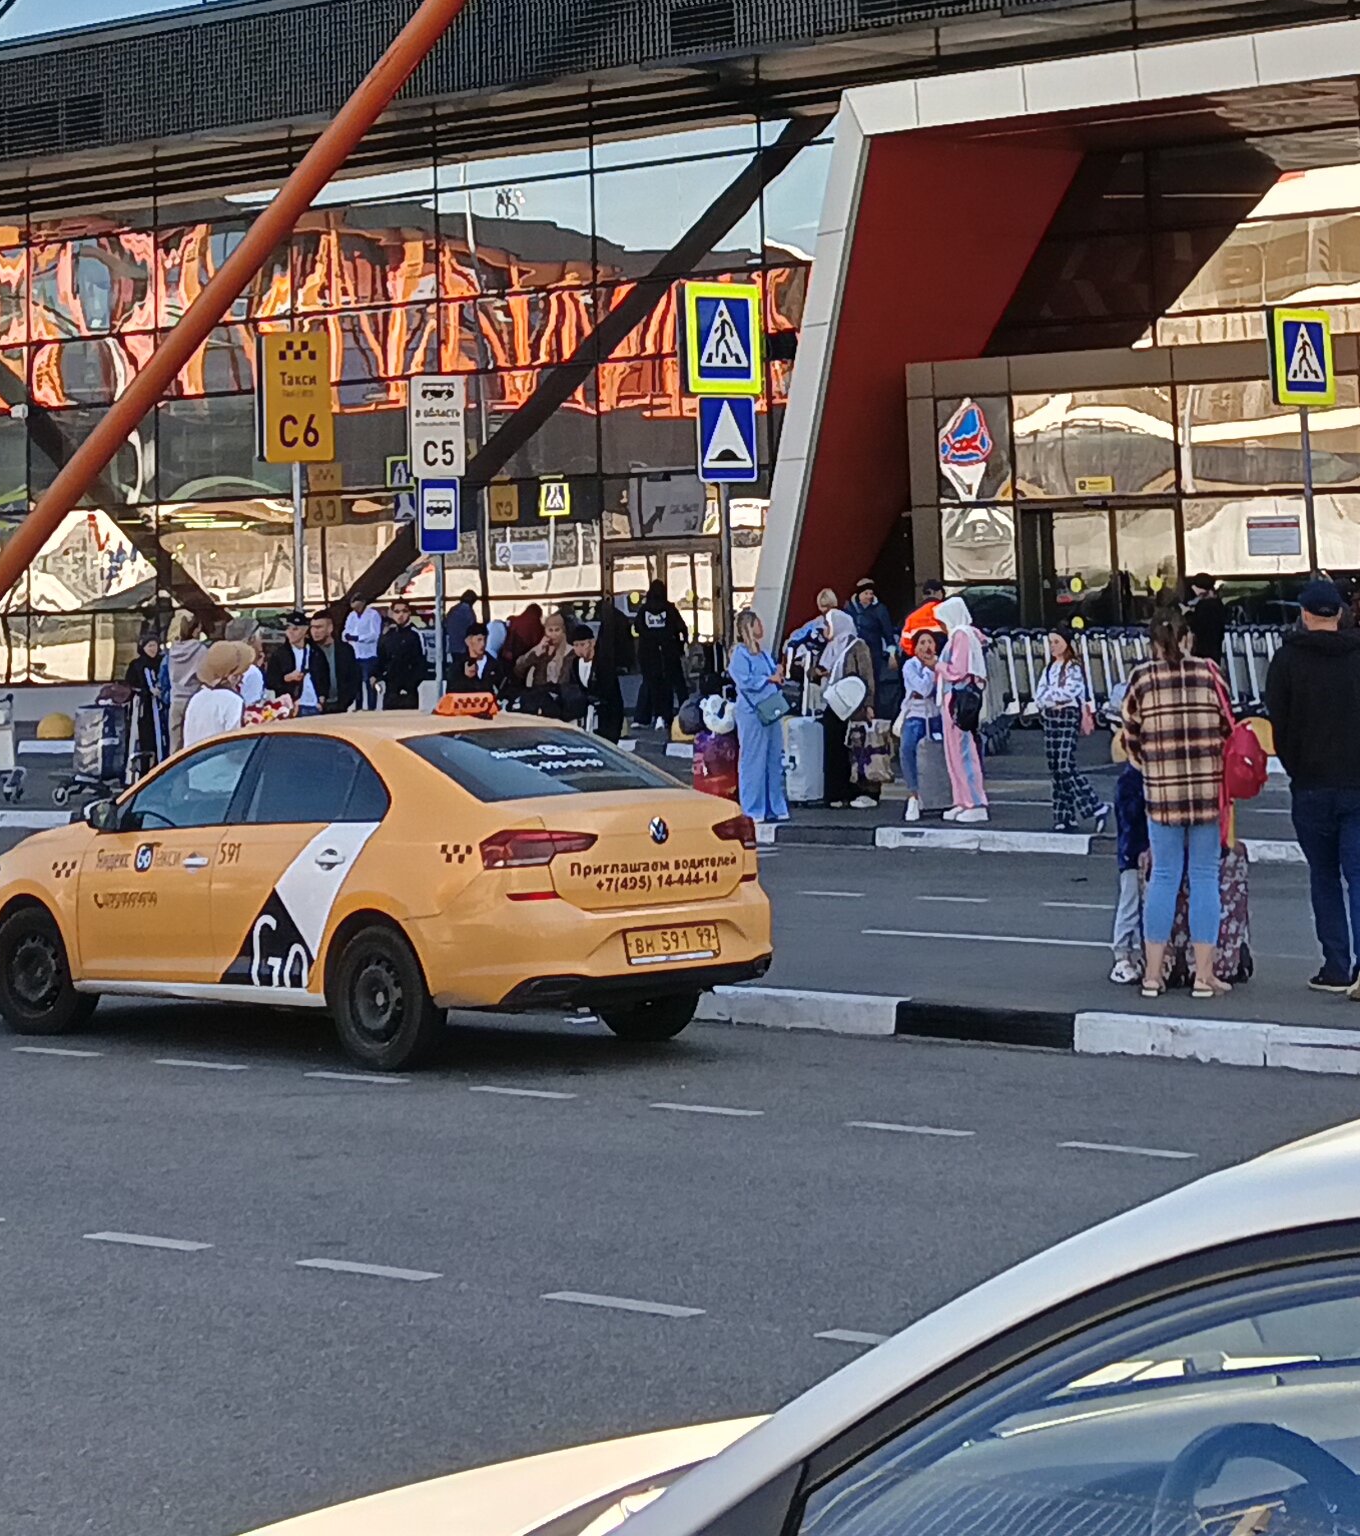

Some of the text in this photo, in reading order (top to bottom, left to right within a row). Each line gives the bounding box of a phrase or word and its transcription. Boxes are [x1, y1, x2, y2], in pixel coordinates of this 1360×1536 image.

[279, 371, 317, 386] Такси
[279, 413, 320, 448] C6
[423, 439, 454, 466] C5
[218, 842, 242, 864] 591
